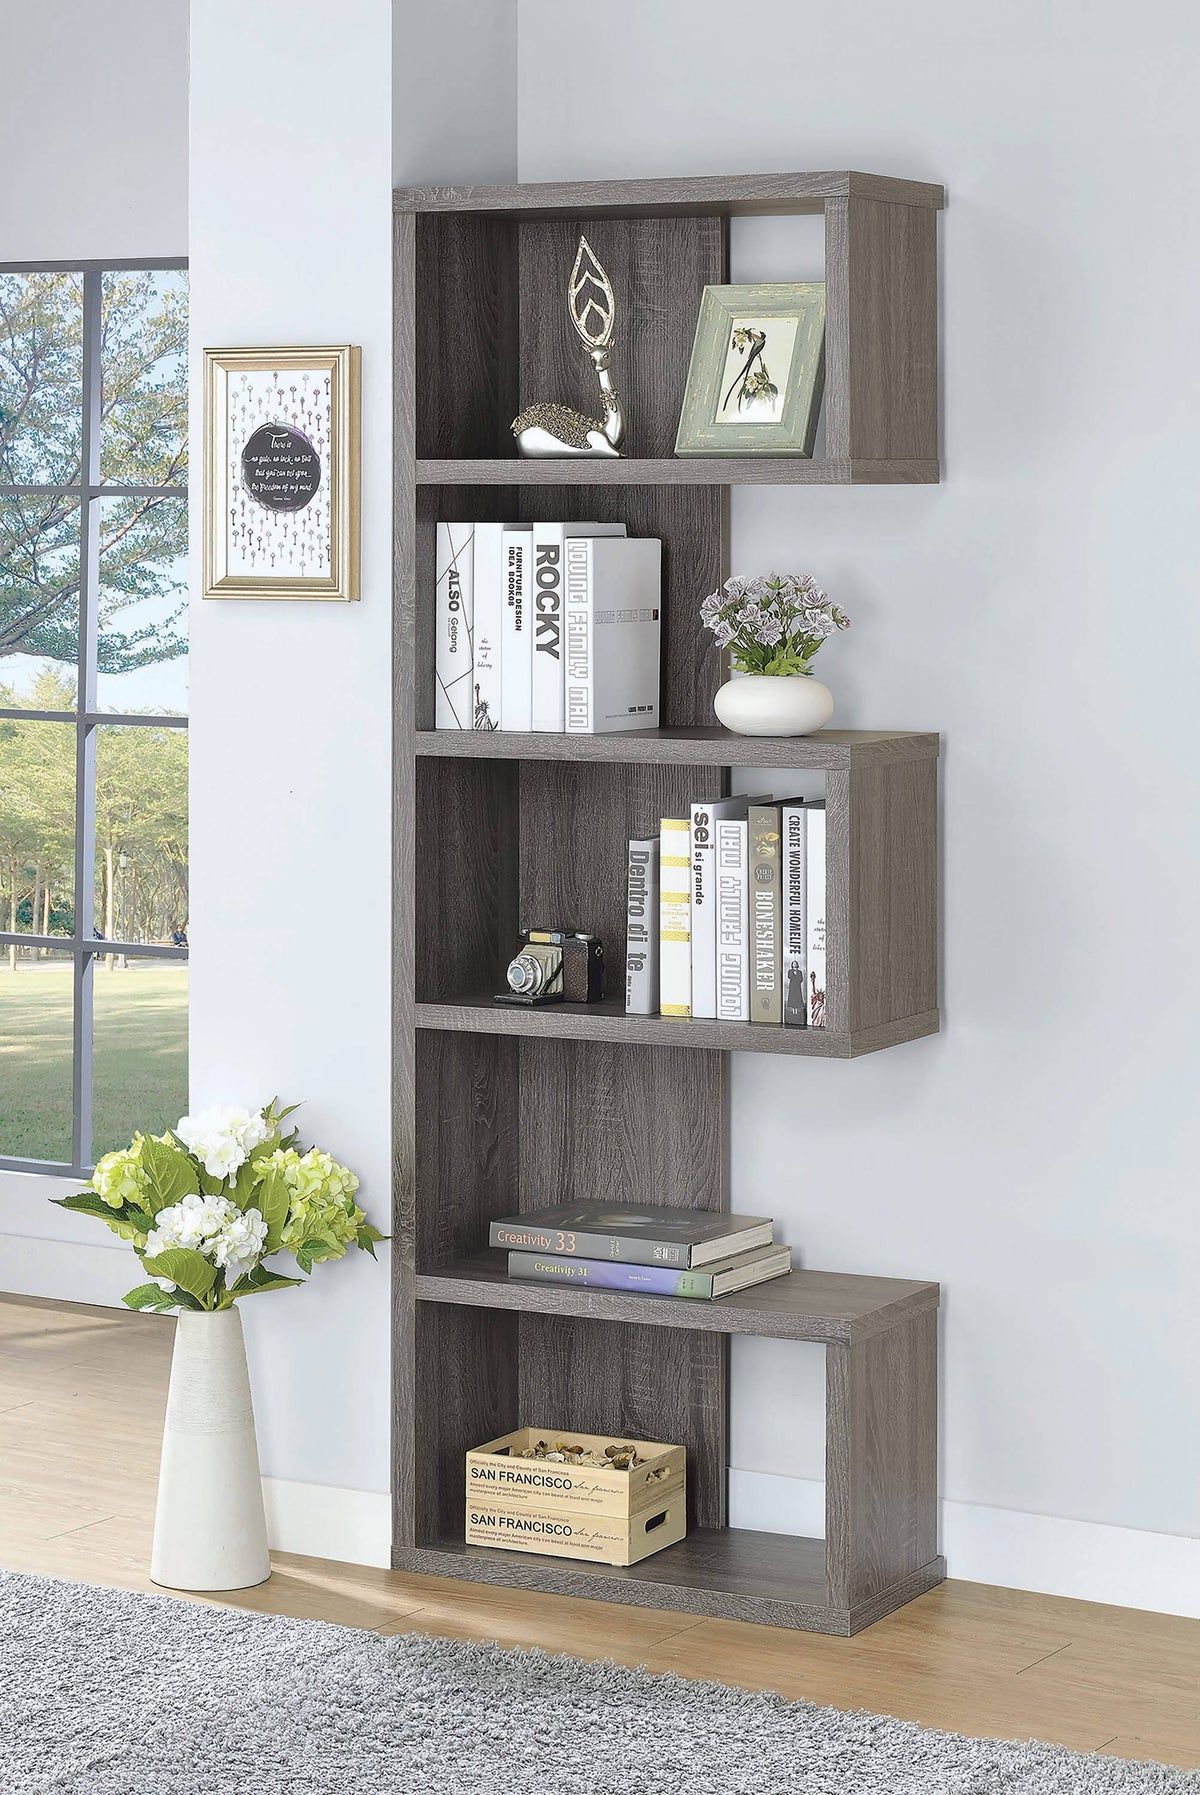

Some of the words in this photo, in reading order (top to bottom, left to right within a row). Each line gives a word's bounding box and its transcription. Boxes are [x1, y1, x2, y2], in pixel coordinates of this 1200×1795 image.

[448, 569, 460, 612] ALSO
[536, 545, 560, 659] ROCKY
[568, 611, 588, 678] FAMILY
[569, 686, 588, 728] MAN
[694, 812, 714, 849] sei
[720, 825, 741, 867] MAN
[789, 815, 800, 847] CREATE
[695, 852, 704, 861] si
[628, 851, 650, 917] Dentro
[693, 864, 704, 905] grande
[789, 850, 801, 906] WONDERFUL
[720, 876, 741, 946] FAMILY
[628, 923, 649, 943] di
[756, 891, 774, 991] BONESHAKER
[789, 910, 801, 954] HOMELIFE
[627, 952, 647, 972] te
[497, 1230, 551, 1249] Creativity
[555, 1232, 576, 1252] 33
[534, 1262, 575, 1276] Creativity
[578, 1267, 587, 1276] 31
[471, 1468, 496, 1480] SAN
[499, 1471, 572, 1490] FRANCISCO
[471, 1514, 496, 1526] SAN
[499, 1517, 572, 1536] FRANCISCO
